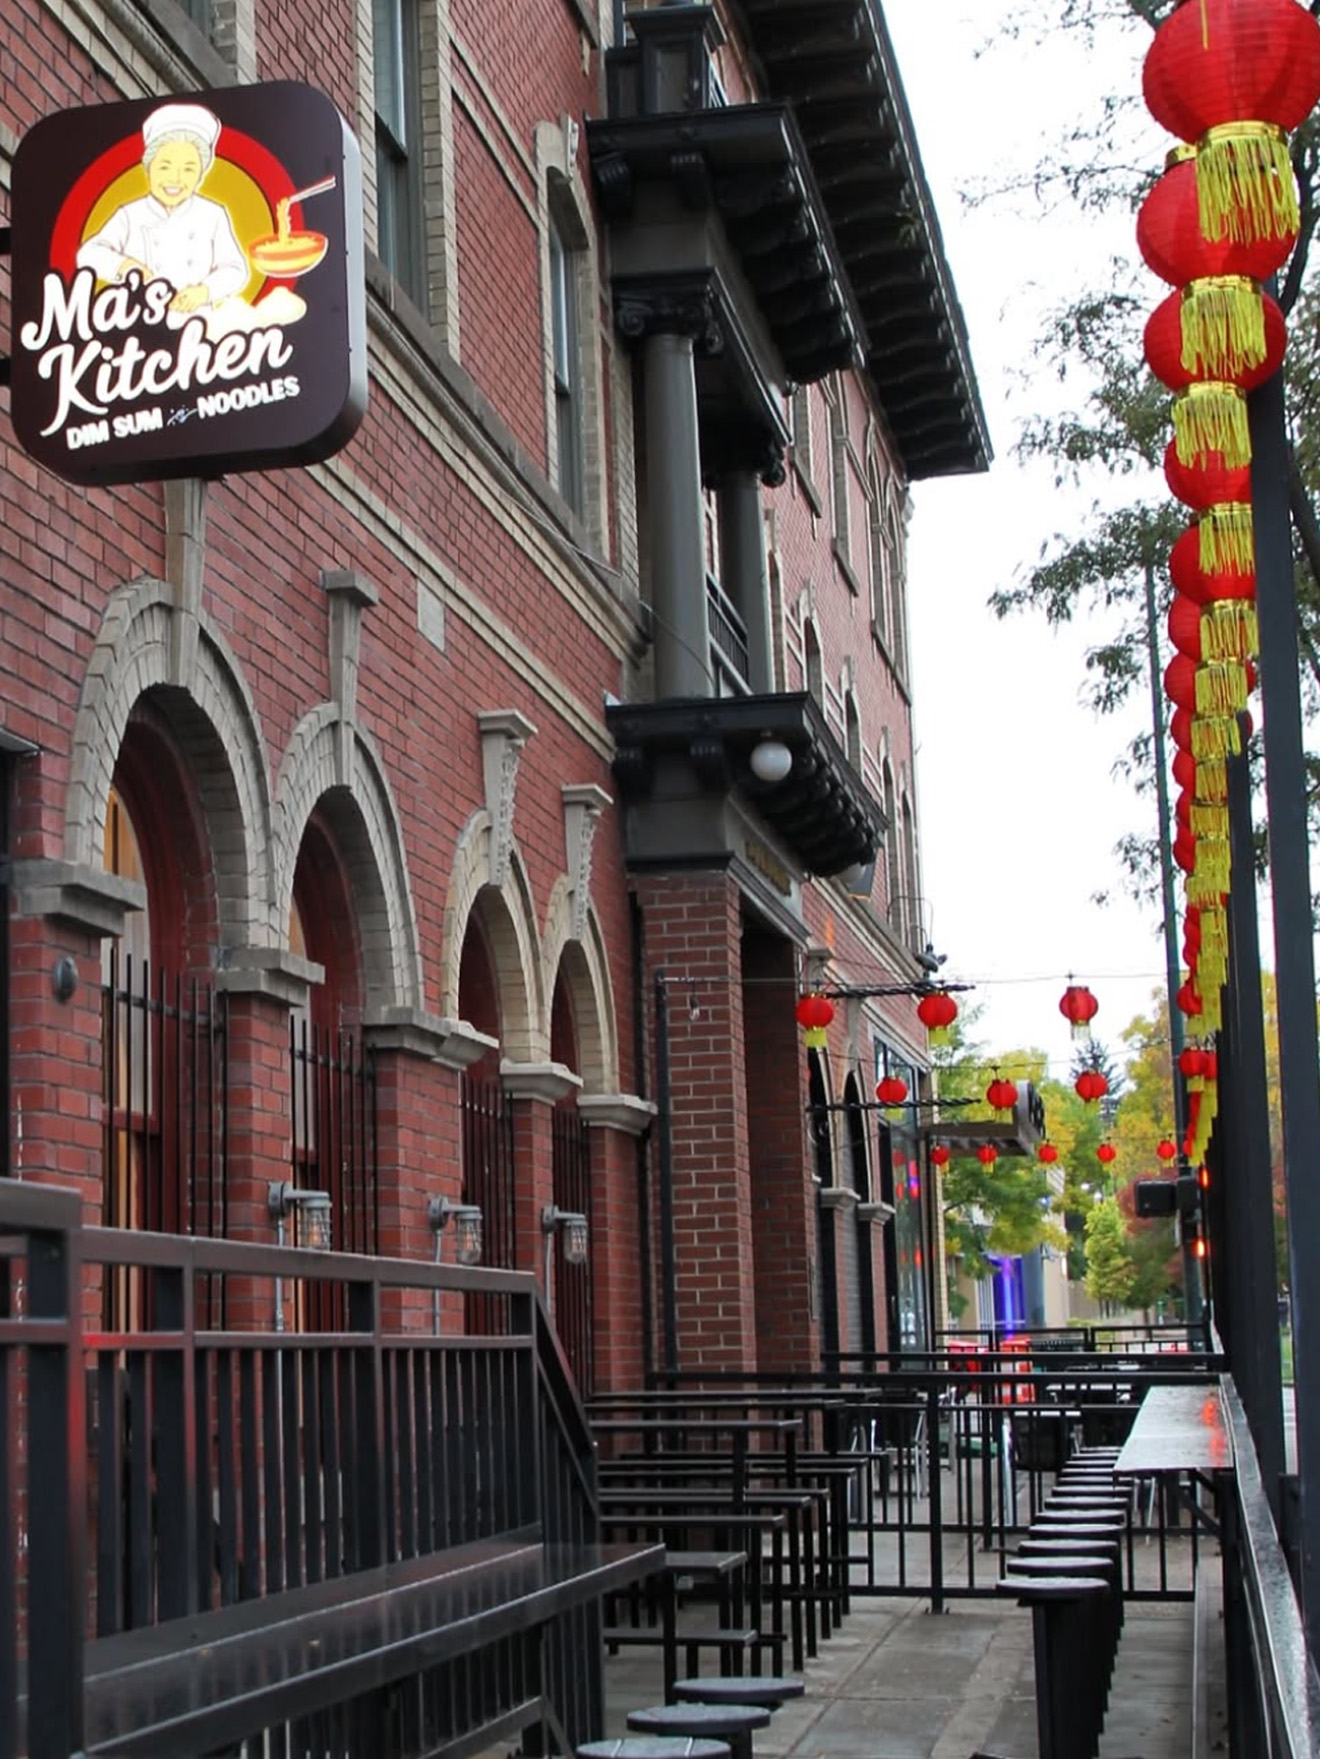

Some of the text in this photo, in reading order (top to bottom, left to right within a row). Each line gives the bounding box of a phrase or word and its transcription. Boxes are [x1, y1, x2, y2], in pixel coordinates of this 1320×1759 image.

[20, 268, 173, 350] Ma's
[38, 318, 294, 437] Kitchen
[66, 376, 300, 450] DIM SUM NOODLES
